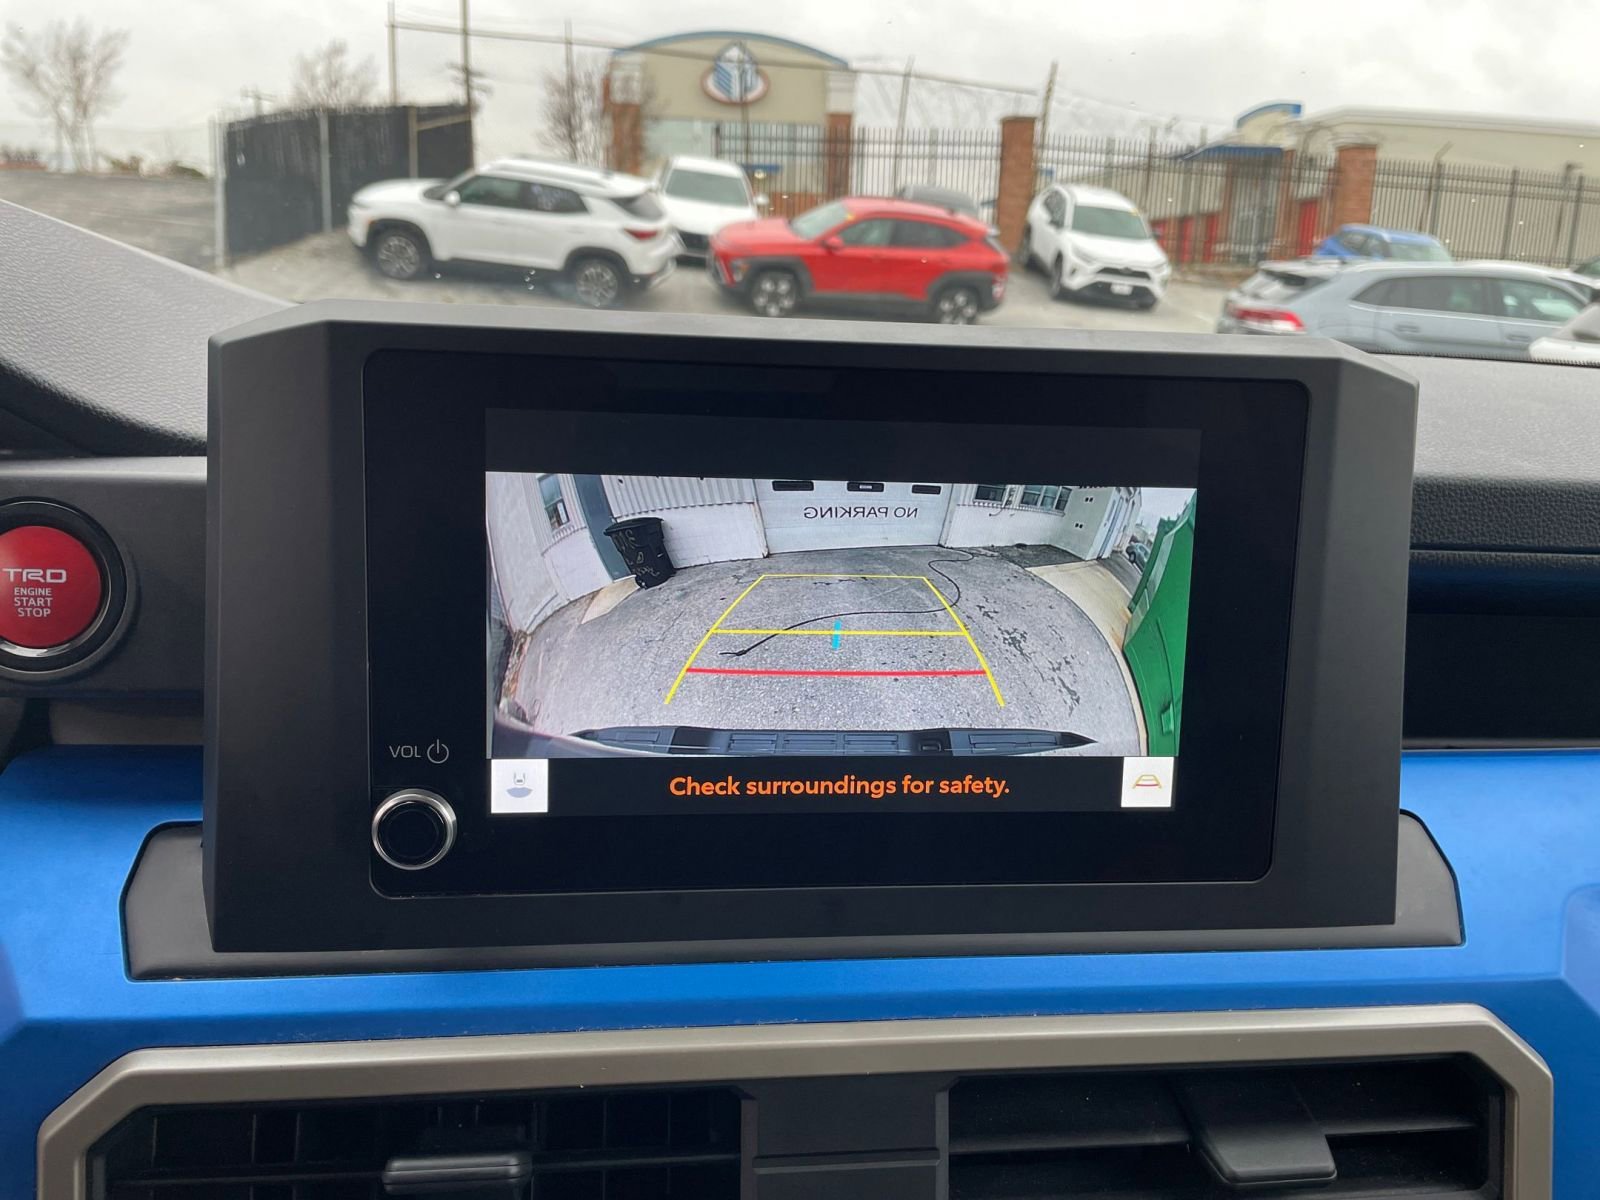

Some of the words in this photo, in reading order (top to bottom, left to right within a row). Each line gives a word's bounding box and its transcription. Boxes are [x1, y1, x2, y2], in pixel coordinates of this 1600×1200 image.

[2, 568, 67, 583] TRD
[14, 587, 52, 596] ENGINE
[14, 597, 53, 607] START
[18, 607, 51, 618] STOP
[389, 745, 421, 758] VOL
[669, 776, 740, 796] Check
[746, 775, 897, 798] surroundings
[902, 775, 934, 794] for
[939, 775, 1010, 798] safety.
